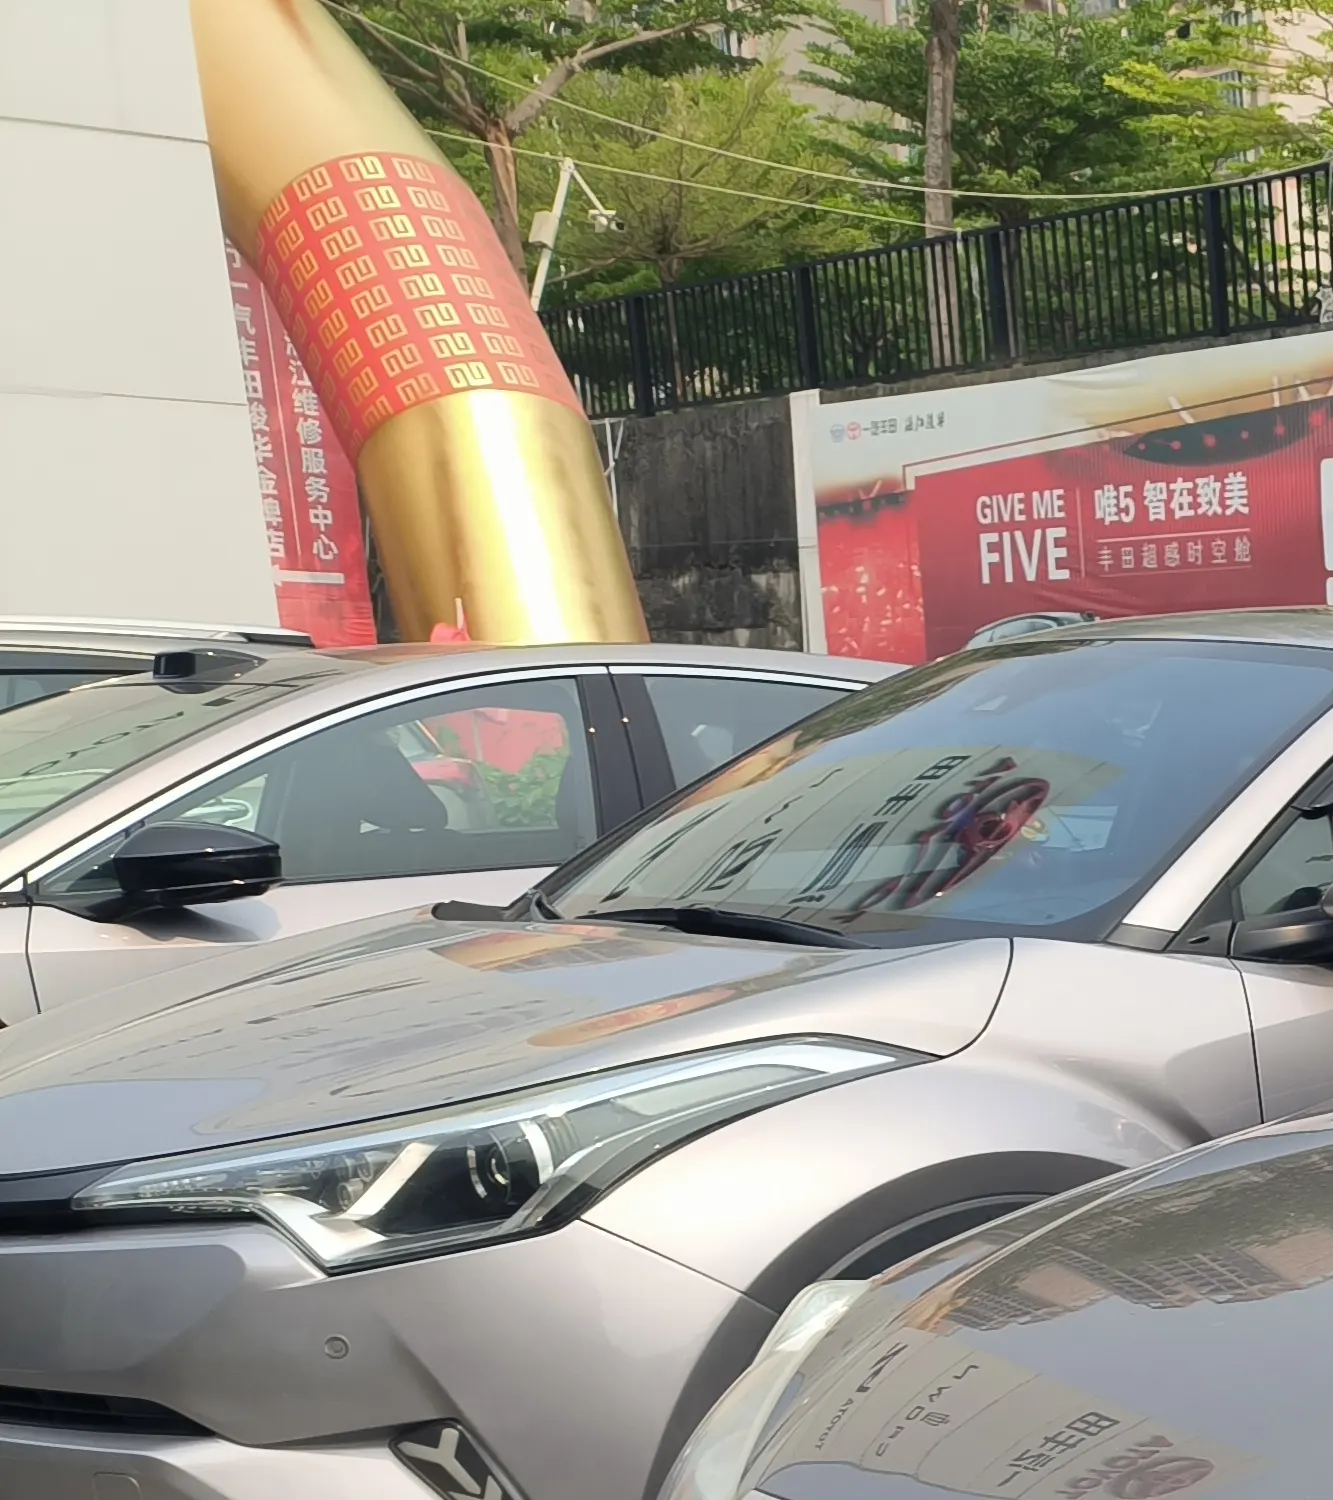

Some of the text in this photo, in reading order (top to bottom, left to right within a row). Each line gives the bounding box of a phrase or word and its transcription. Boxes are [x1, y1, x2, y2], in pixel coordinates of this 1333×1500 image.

[976, 489, 1067, 525] GIVE ME
[1094, 471, 1250, 526] 唯5 智在致美
[979, 527, 1071, 585] FIVE
